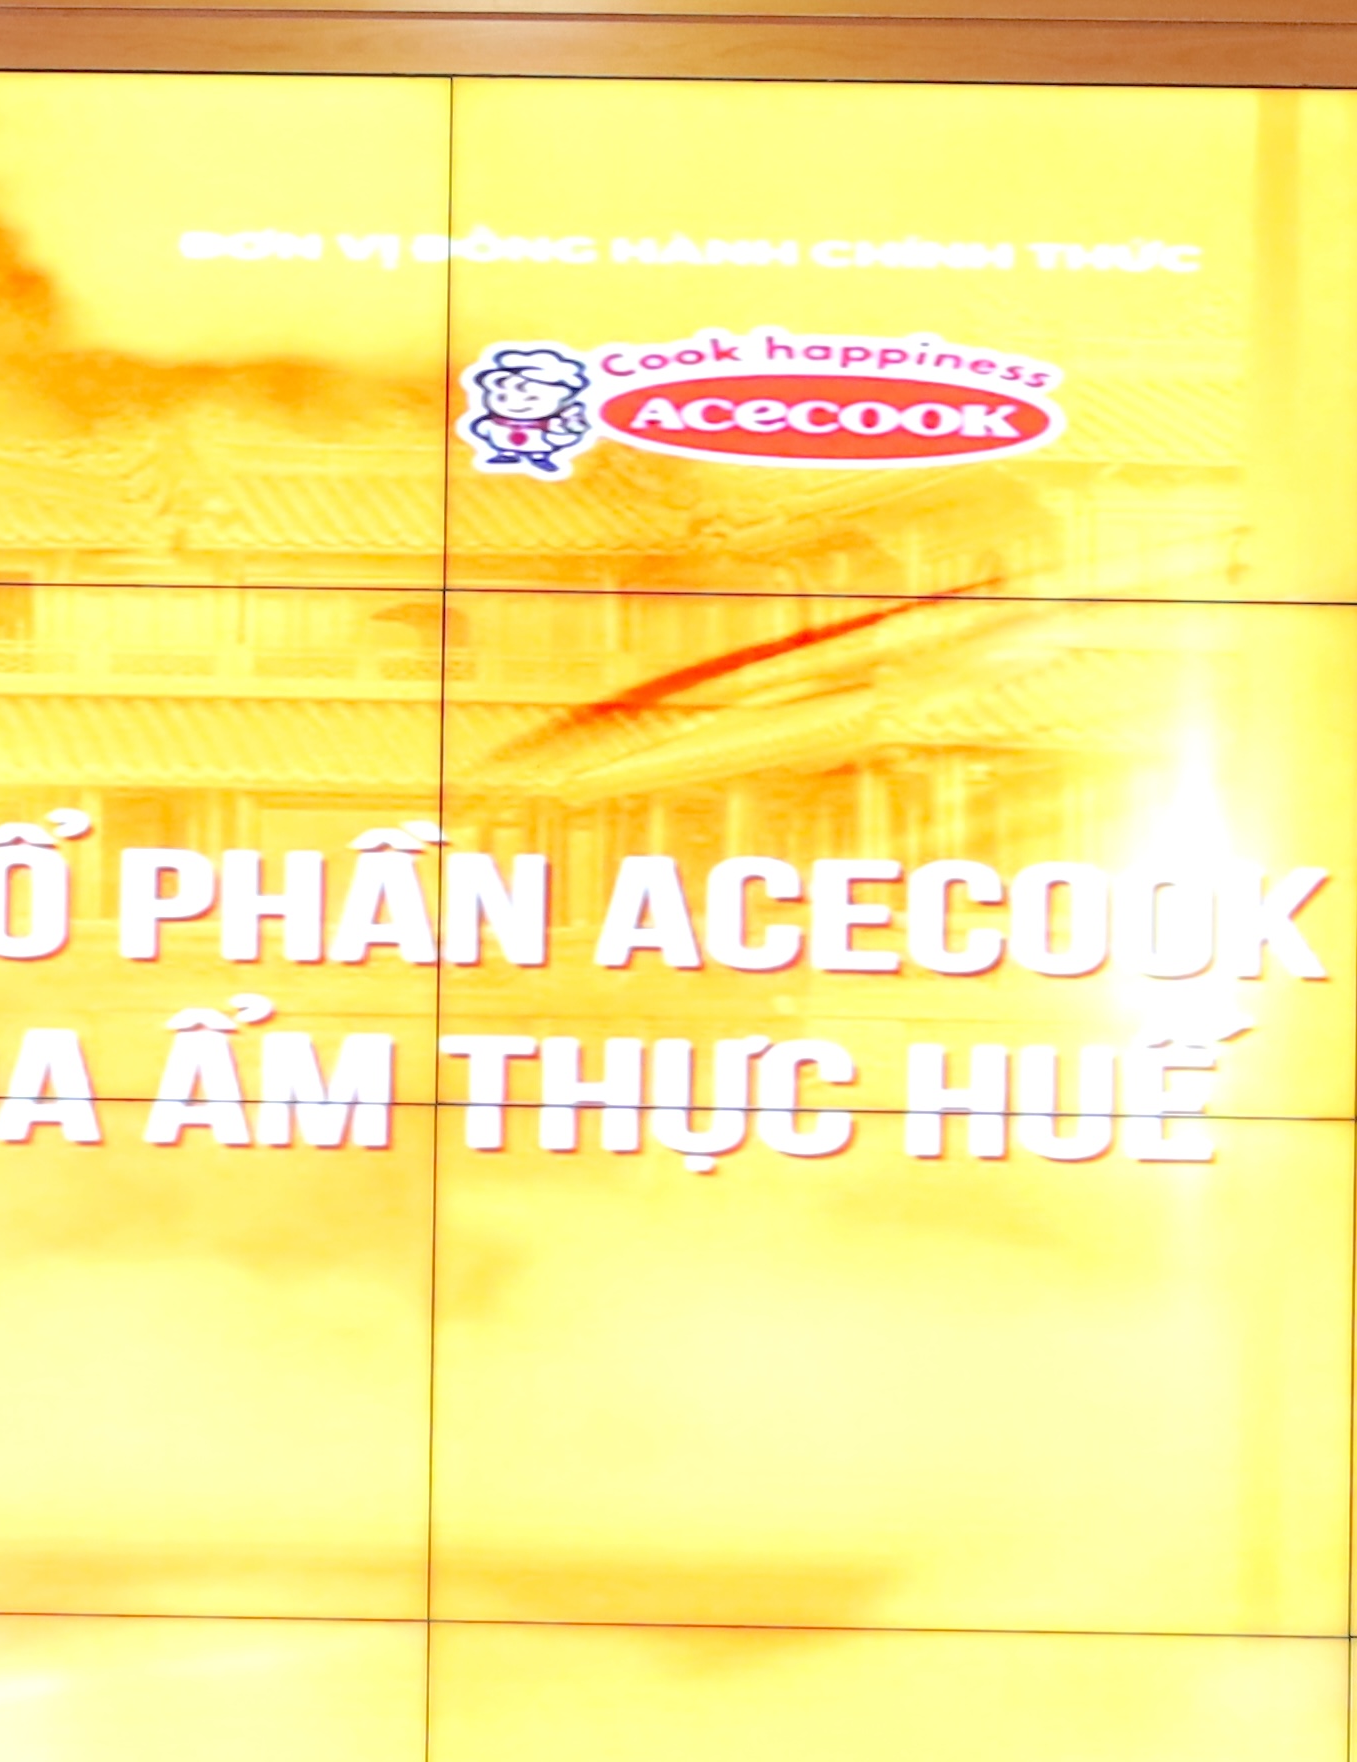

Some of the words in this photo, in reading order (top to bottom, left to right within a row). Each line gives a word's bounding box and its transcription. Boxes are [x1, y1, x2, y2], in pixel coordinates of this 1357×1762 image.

[610, 234, 799, 266] HÀNH
[600, 338, 742, 377] Cook
[766, 336, 1052, 388] happiness
[119, 820, 546, 964] PHẦN
[595, 855, 1328, 982] ACECOOK
[143, 993, 393, 1146] ẨM
[439, 1035, 855, 1171] THỰC
[905, 1013, 1253, 1161] HUẾ
